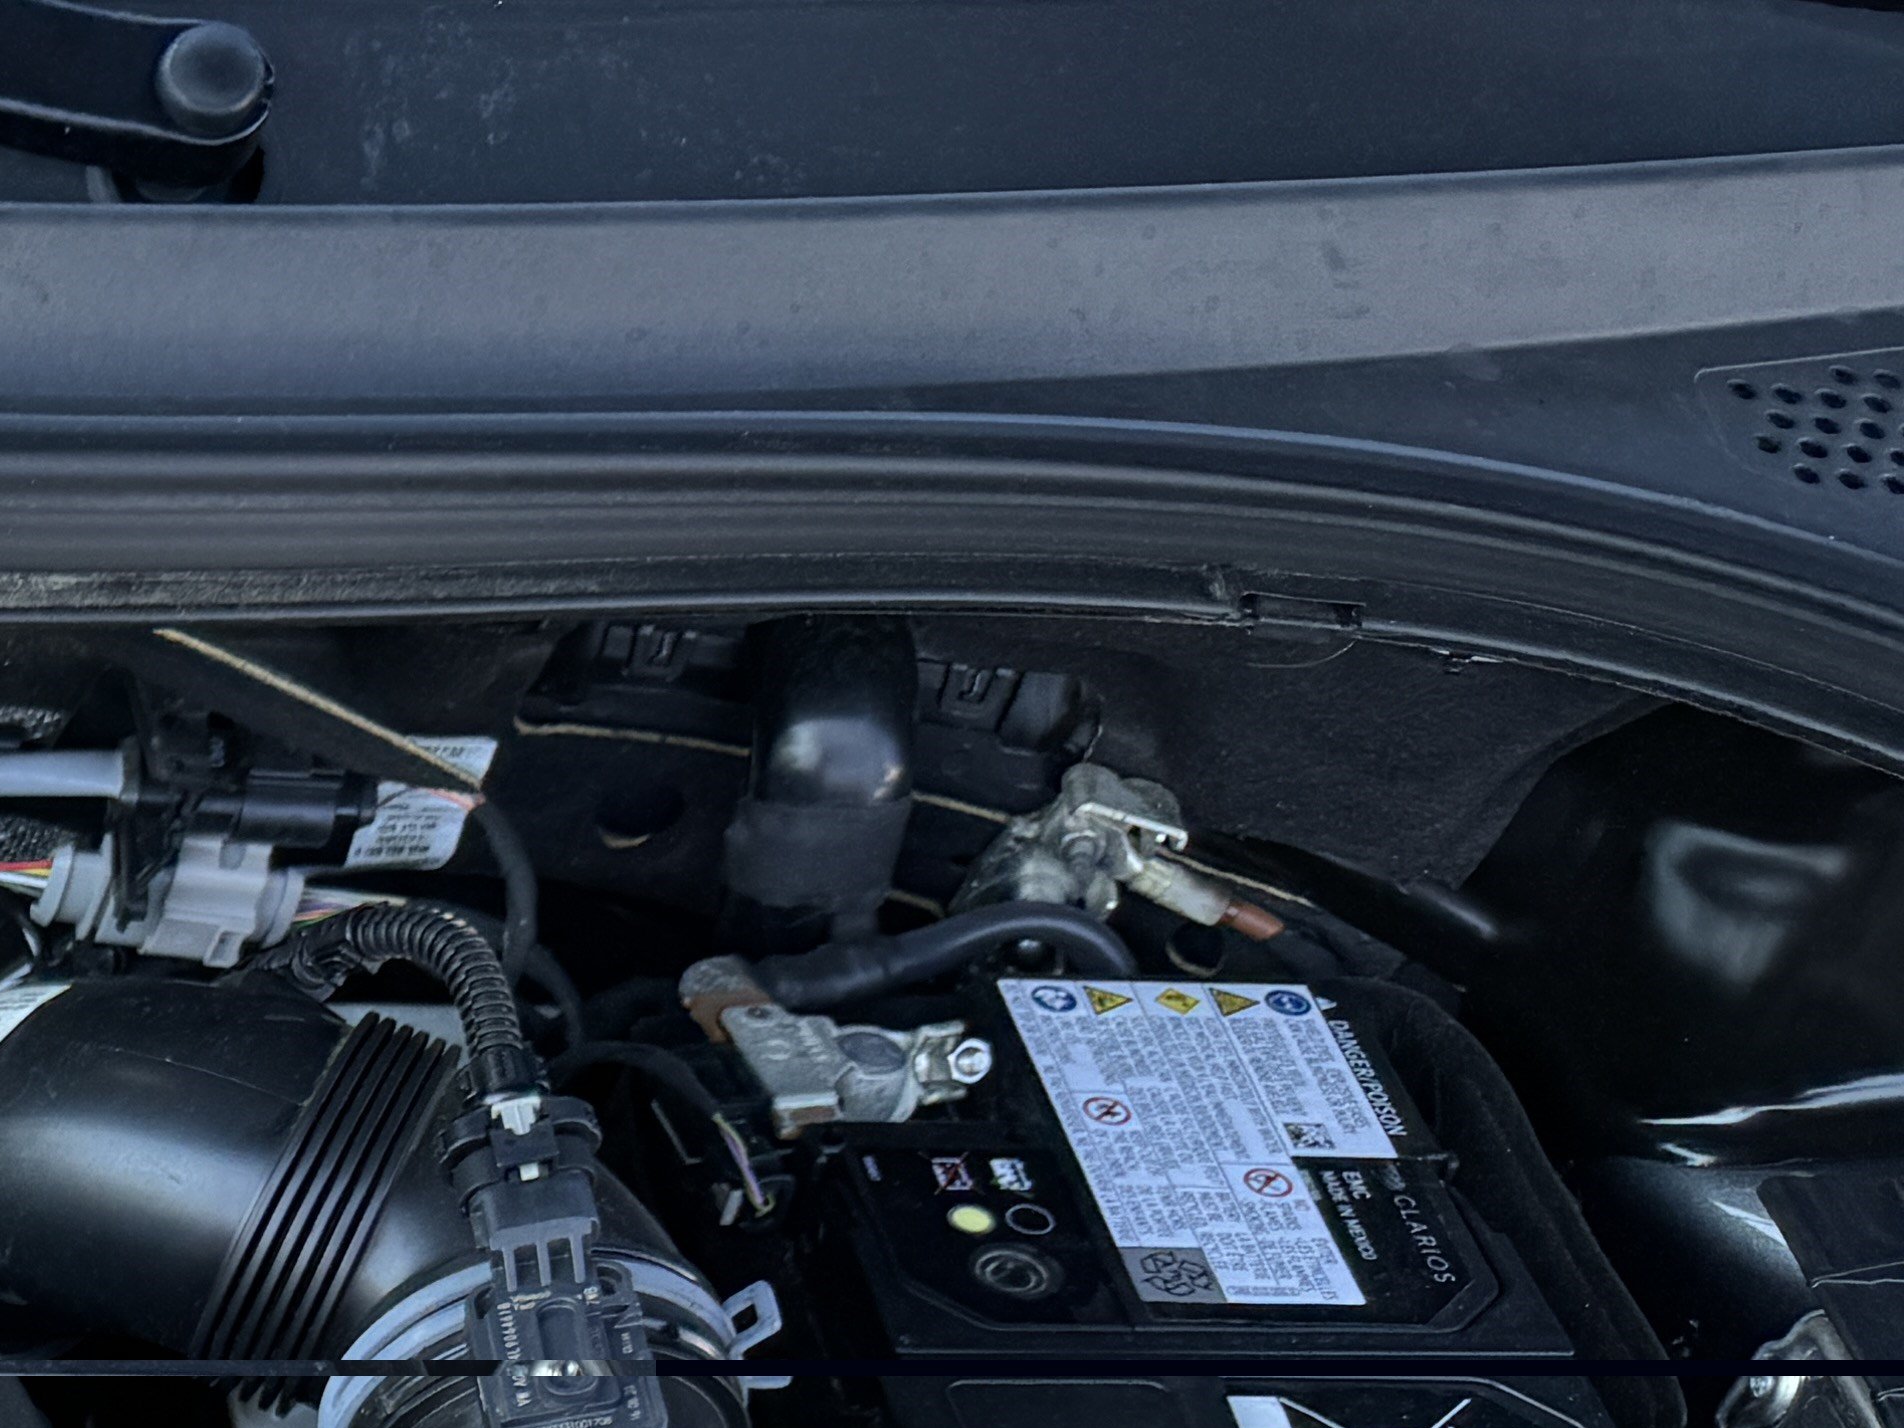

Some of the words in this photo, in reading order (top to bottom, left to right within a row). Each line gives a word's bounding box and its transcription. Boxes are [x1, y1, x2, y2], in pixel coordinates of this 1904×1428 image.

[1326, 1019, 1407, 1137] DANGER/POISON
[1321, 1171, 1350, 1202] MADE
[1336, 1203, 1355, 1218] IN
[1393, 1194, 1456, 1283] CLARIOS
